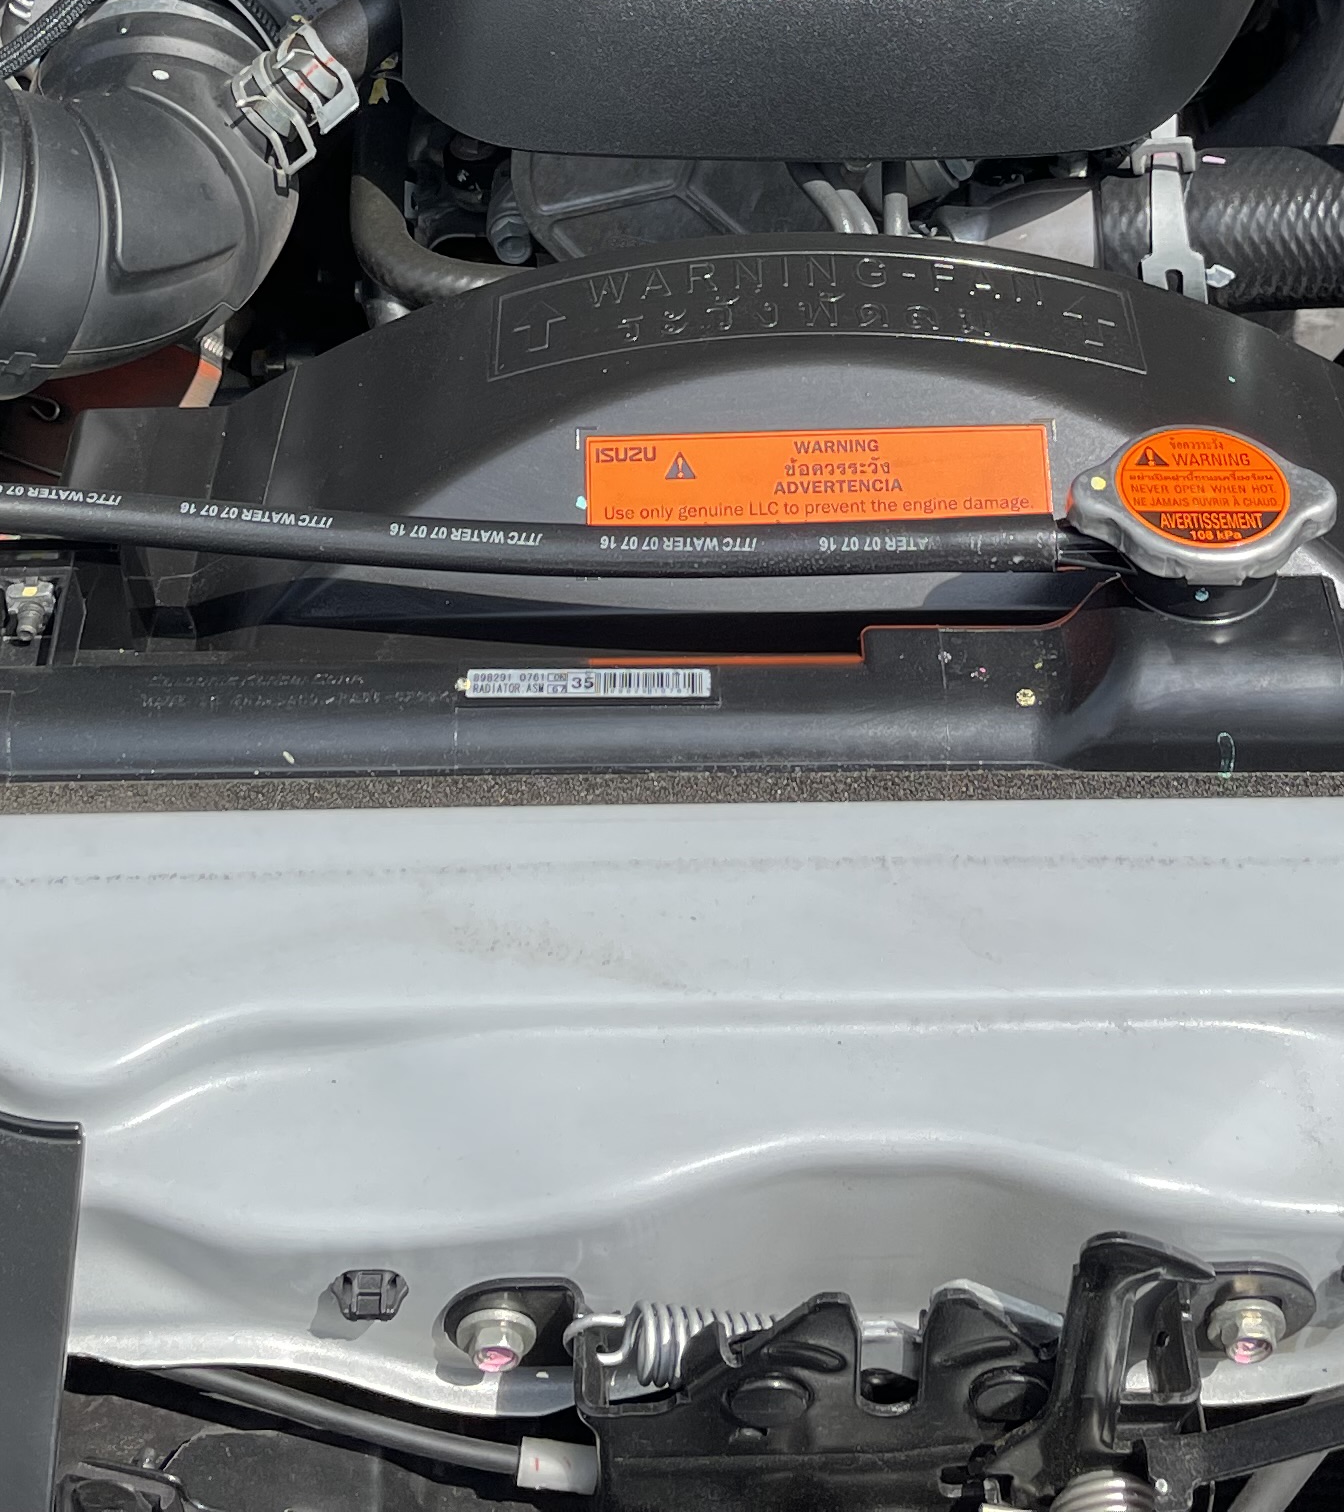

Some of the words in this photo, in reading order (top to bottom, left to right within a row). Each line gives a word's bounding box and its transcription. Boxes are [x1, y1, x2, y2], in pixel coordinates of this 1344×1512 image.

[794, 439, 879, 454] WARNING
[595, 447, 656, 463] ISUZU
[1171, 453, 1251, 467] WARNING
[784, 458, 891, 476] ข้อควรระวัง
[7, 484, 26, 497] 07
[774, 479, 903, 495] ADVERTENCIA
[1131, 484, 1169, 494] NEVER
[1175, 484, 1205, 494] OPEN
[1210, 484, 1246, 494] WHEN
[27, 486, 84, 504] WATER
[180, 501, 197, 514] 16
[201, 503, 219, 516] 07
[604, 506, 634, 520] Use
[640, 504, 673, 522] only
[678, 503, 744, 521] genuine
[749, 501, 779, 516] LLC
[784, 501, 801, 515] to
[804, 500, 866, 517] prevent
[871, 498, 898, 513] the
[902, 497, 958, 515] engine
[963, 495, 1034, 513] damage.
[1133, 498, 1147, 506] NE
[1150, 498, 1189, 507] JAMAIS
[1192, 498, 1229, 507] OUVRIR
[222, 505, 239, 519] 07
[242, 507, 296, 525] WATER
[1160, 513, 1262, 529] AVERTISSEMENT
[390, 523, 405, 536] 16
[410, 526, 427, 538] 07
[430, 526, 447, 539] 07
[451, 528, 504, 543] WATER
[1216, 531, 1243, 540] kPa
[600, 536, 617, 550] 16
[621, 536, 639, 550] 07
[642, 536, 660, 550] 07
[663, 536, 719, 553] WATER
[819, 536, 836, 552] 16
[841, 536, 858, 551] 07
[864, 536, 880, 551] 07
[571, 677, 594, 689] 35
